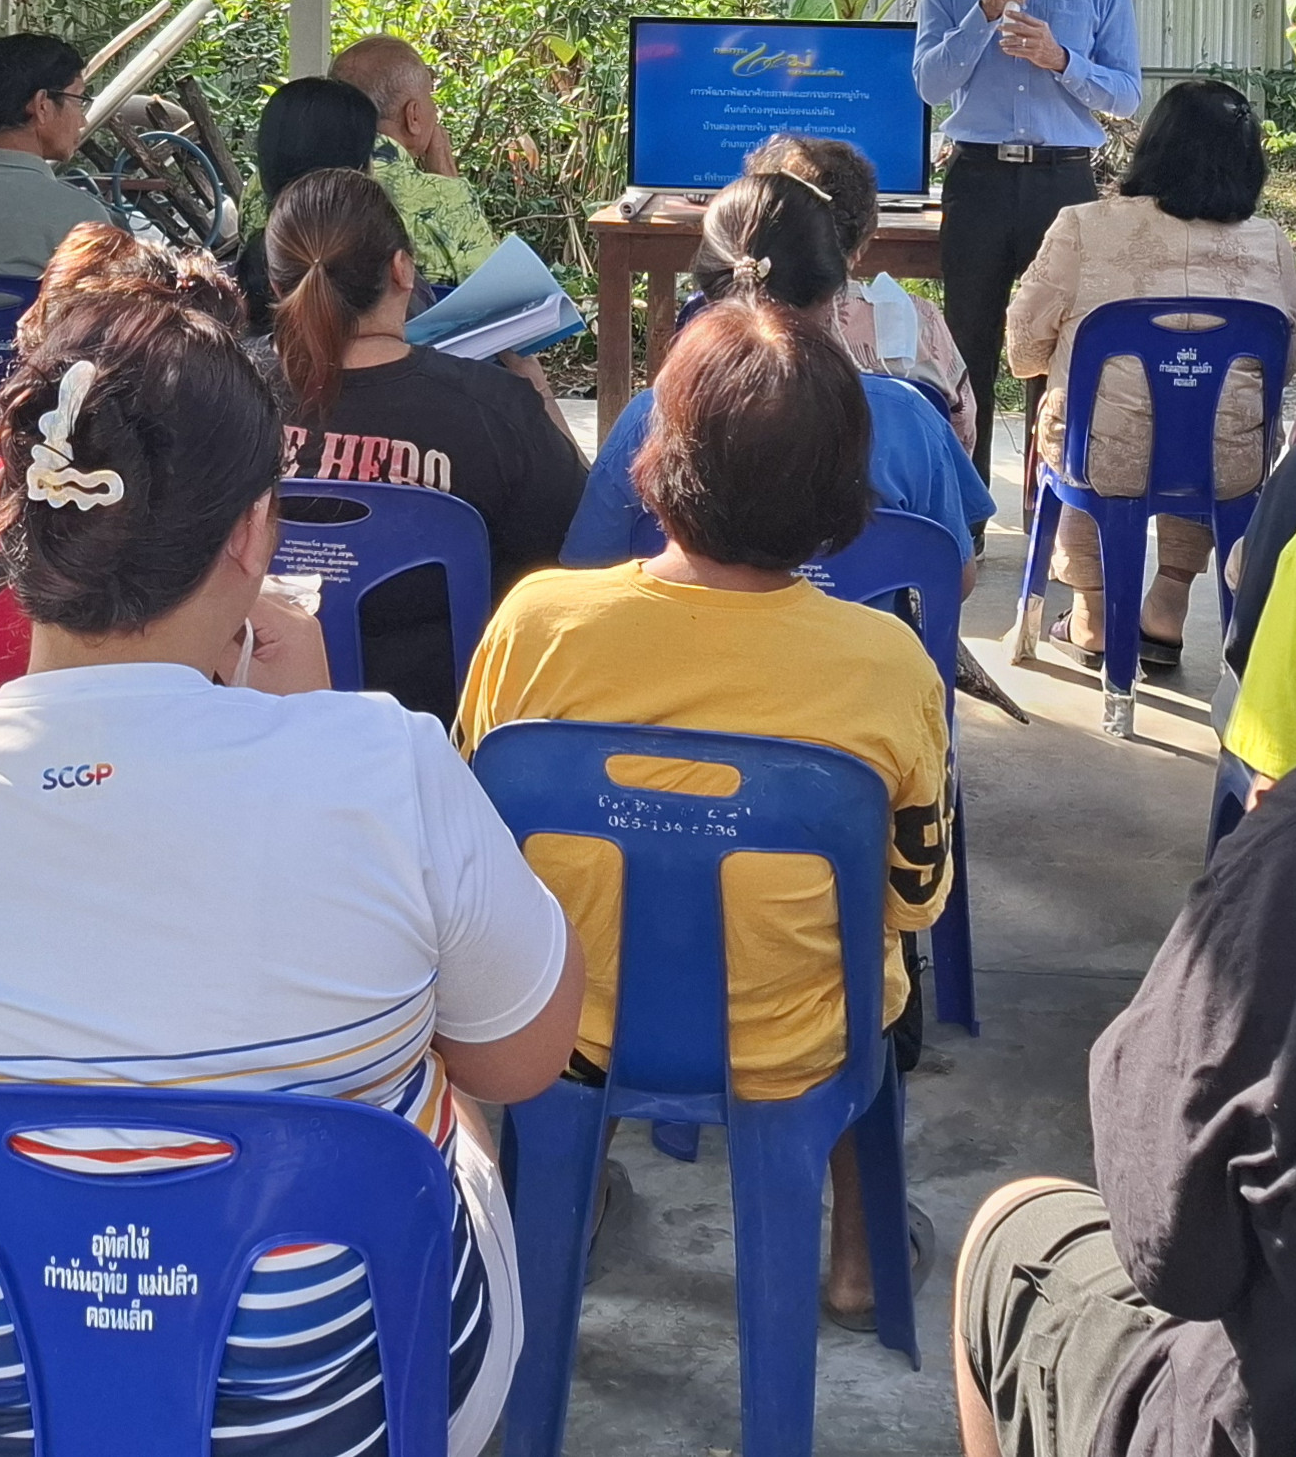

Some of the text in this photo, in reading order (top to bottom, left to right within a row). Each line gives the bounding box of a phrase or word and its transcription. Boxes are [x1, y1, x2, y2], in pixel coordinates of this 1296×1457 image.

[42, 763, 114, 791] SCGP
[92, 1223, 150, 1267] อุทิศให้
[44, 1255, 199, 1303] กำนันอุทัย แม่ปลิว
